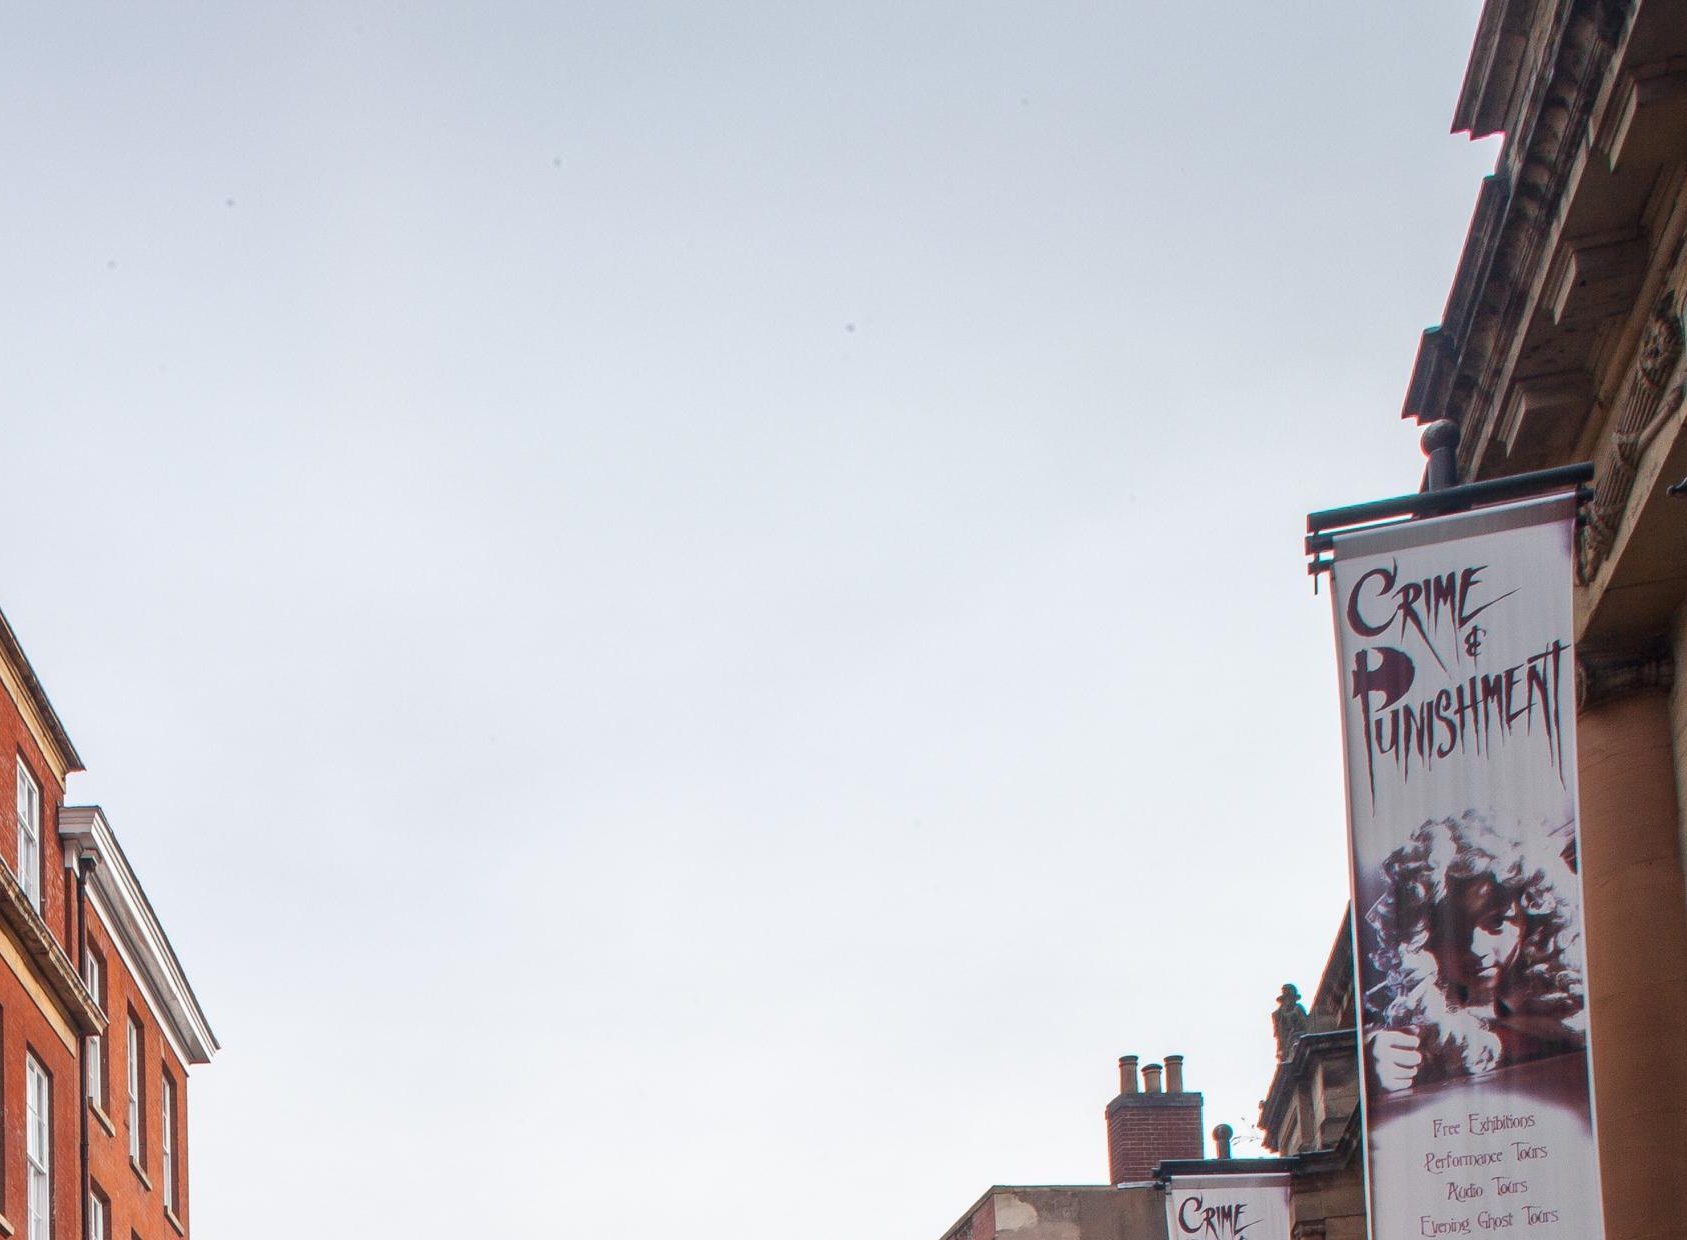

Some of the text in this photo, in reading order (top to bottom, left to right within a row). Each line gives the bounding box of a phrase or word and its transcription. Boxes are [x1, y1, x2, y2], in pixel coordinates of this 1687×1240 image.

[1464, 625, 1487, 668] &
[1433, 1113, 1535, 1138] Free Exhibitions
[1424, 1142, 1548, 1174] Performance Tours
[1447, 1176, 1528, 1202] Audio Tours
[1420, 1206, 1559, 1237] Evening Ghost Tours
